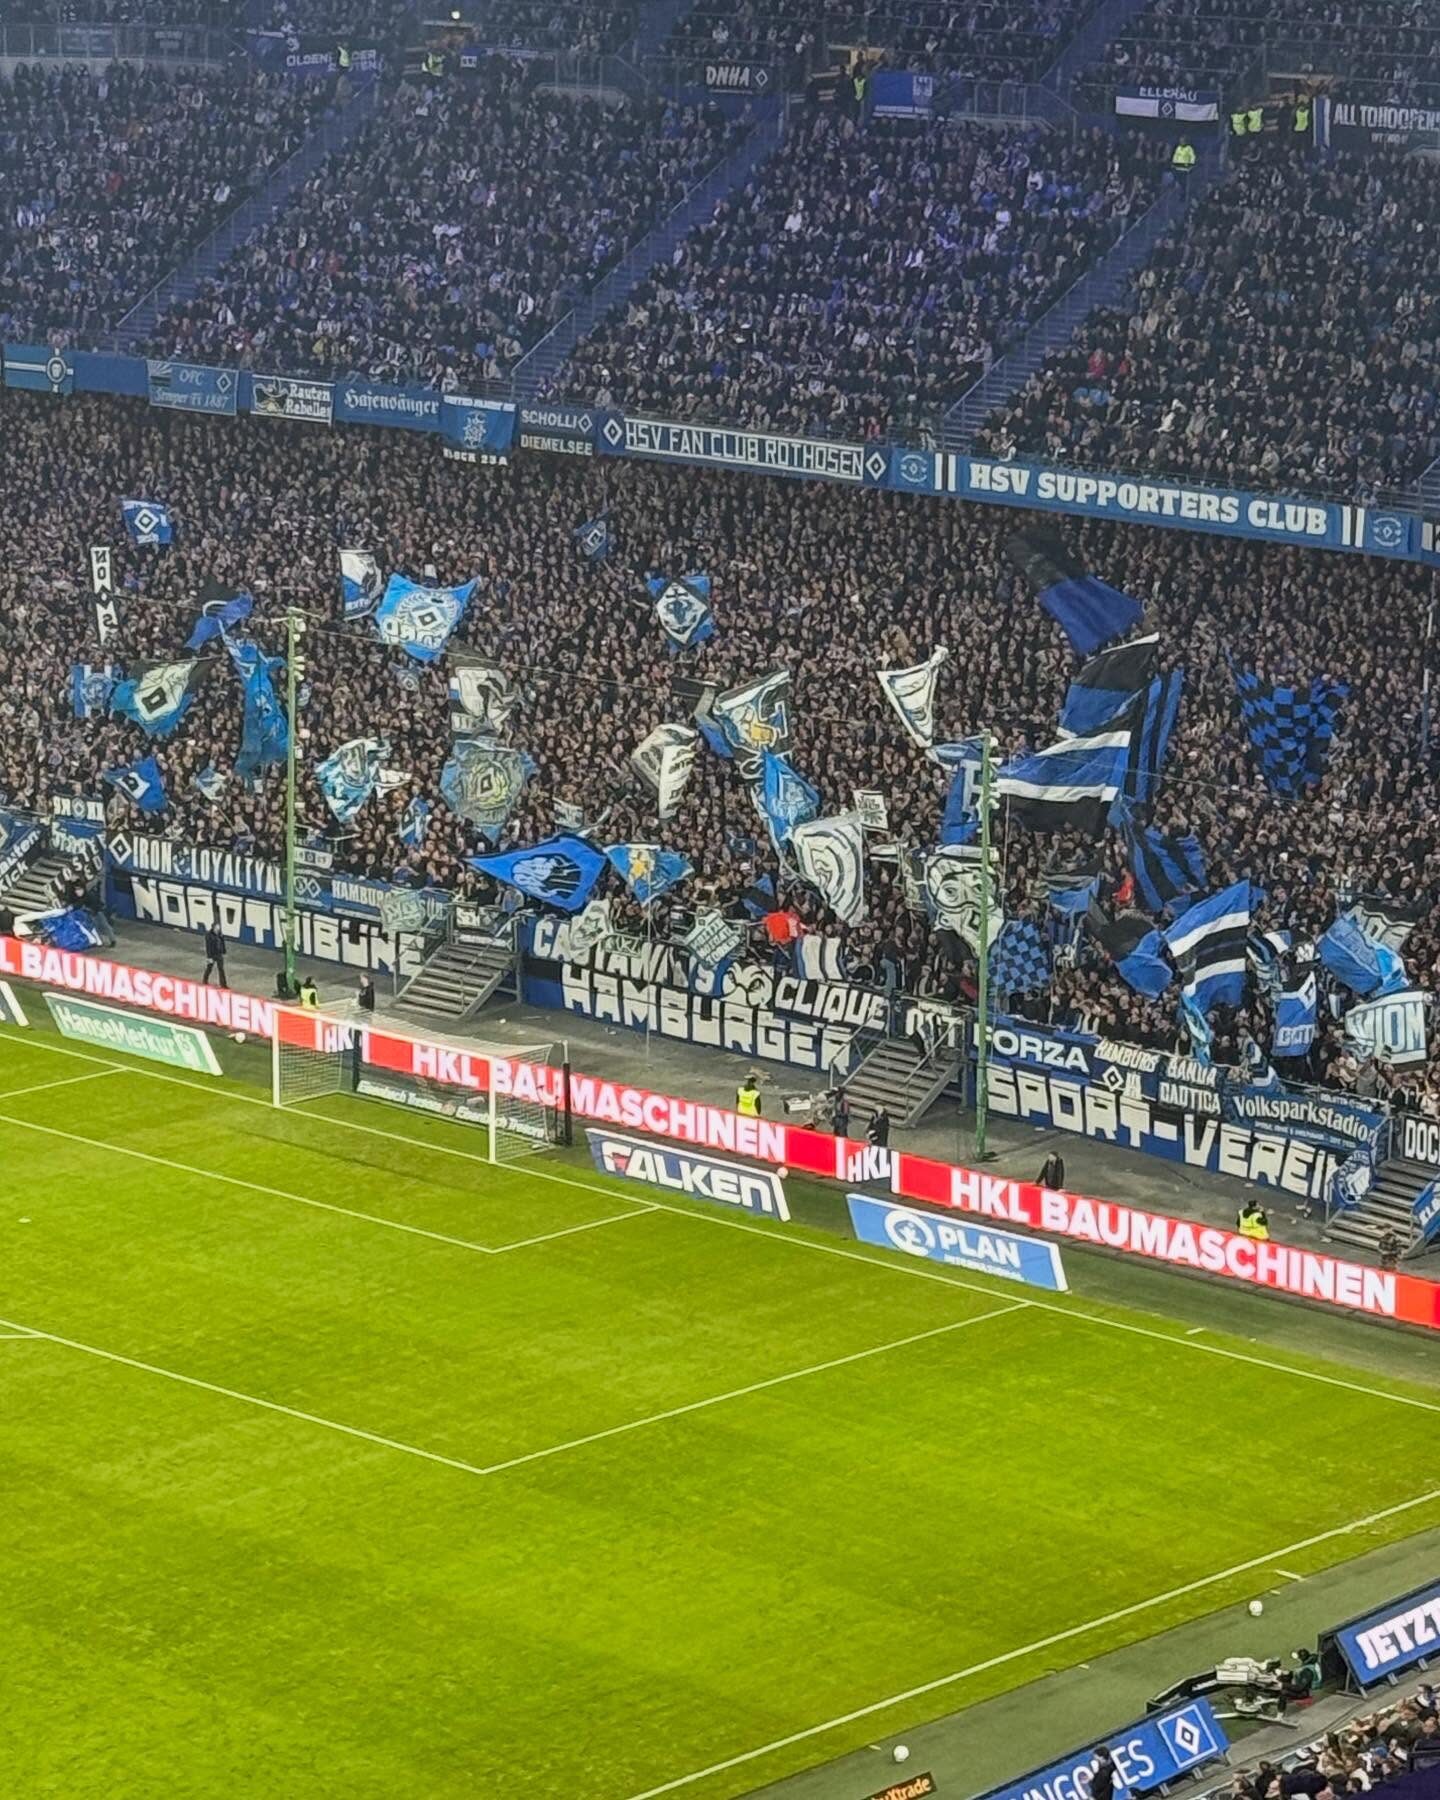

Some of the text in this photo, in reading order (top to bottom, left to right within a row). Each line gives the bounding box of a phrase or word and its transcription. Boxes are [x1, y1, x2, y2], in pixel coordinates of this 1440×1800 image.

[706, 64, 750, 88] DNHA
[1333, 103, 1357, 126] ALL
[289, 383, 331, 402] Rauten
[521, 409, 578, 429] SCHOLLI
[520, 434, 593, 456] DIEMELSEE
[625, 422, 864, 476] HSV FAN CLUB ROTHOSEN
[969, 462, 1328, 536] HSV SUPPORTERS CLUB
[133, 836, 172, 875] IRON
[191, 847, 263, 893] LOYALTY
[22, 943, 275, 1039] BAUMASCHINEN
[775, 976, 889, 1030] CLIQUE
[56, 1004, 177, 1058] HanseMerkur
[562, 963, 852, 1077] HAMBURGER
[412, 1043, 786, 1163] HKL BAUMASCHINEN
[601, 1141, 773, 1214] FALKEN
[848, 1145, 892, 1183] HKL
[936, 1224, 1022, 1268] PLAN
[950, 1167, 1396, 1316] HKL BAUMASCHINEN
